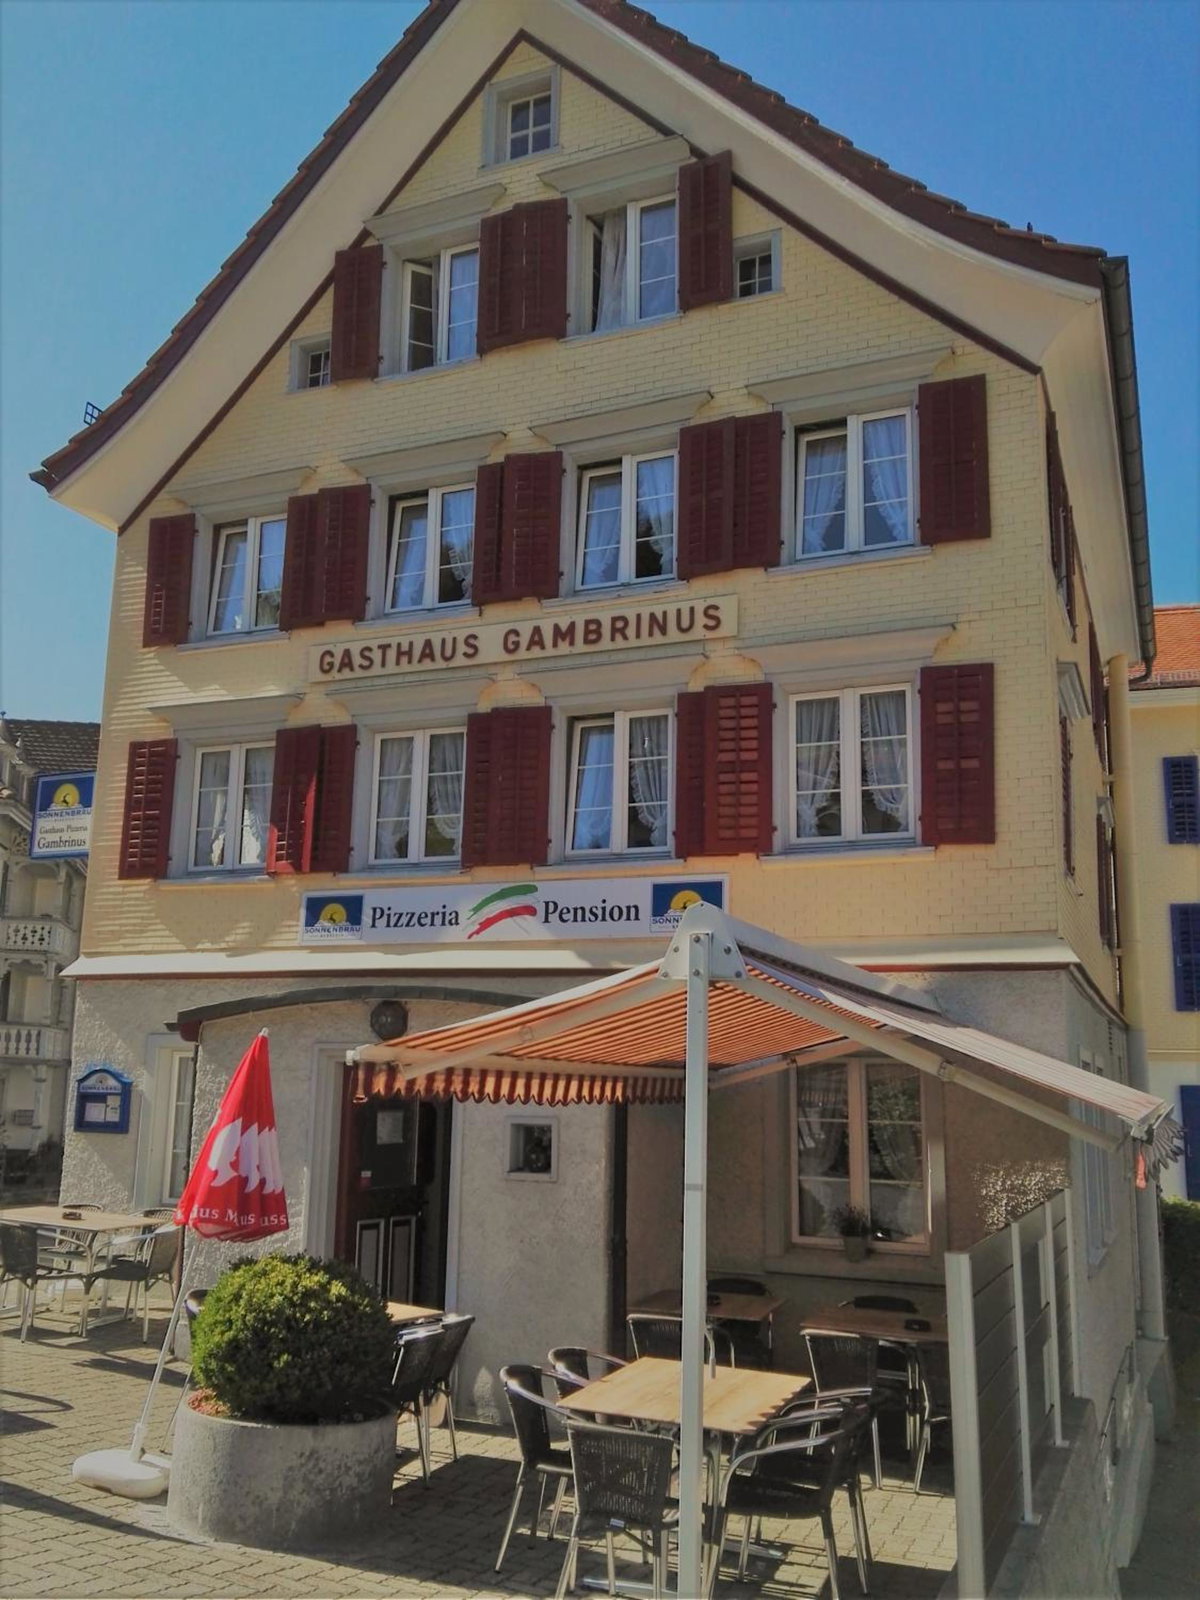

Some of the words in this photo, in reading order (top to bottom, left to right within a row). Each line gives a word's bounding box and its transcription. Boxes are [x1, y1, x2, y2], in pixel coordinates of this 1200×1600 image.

[319, 633, 479, 674] GASTHAUS
[502, 604, 722, 655] GAMBRINUS
[37, 835, 86, 850] Gambrinus
[369, 904, 460, 929] Pizzeria
[542, 898, 641, 924] Pension
